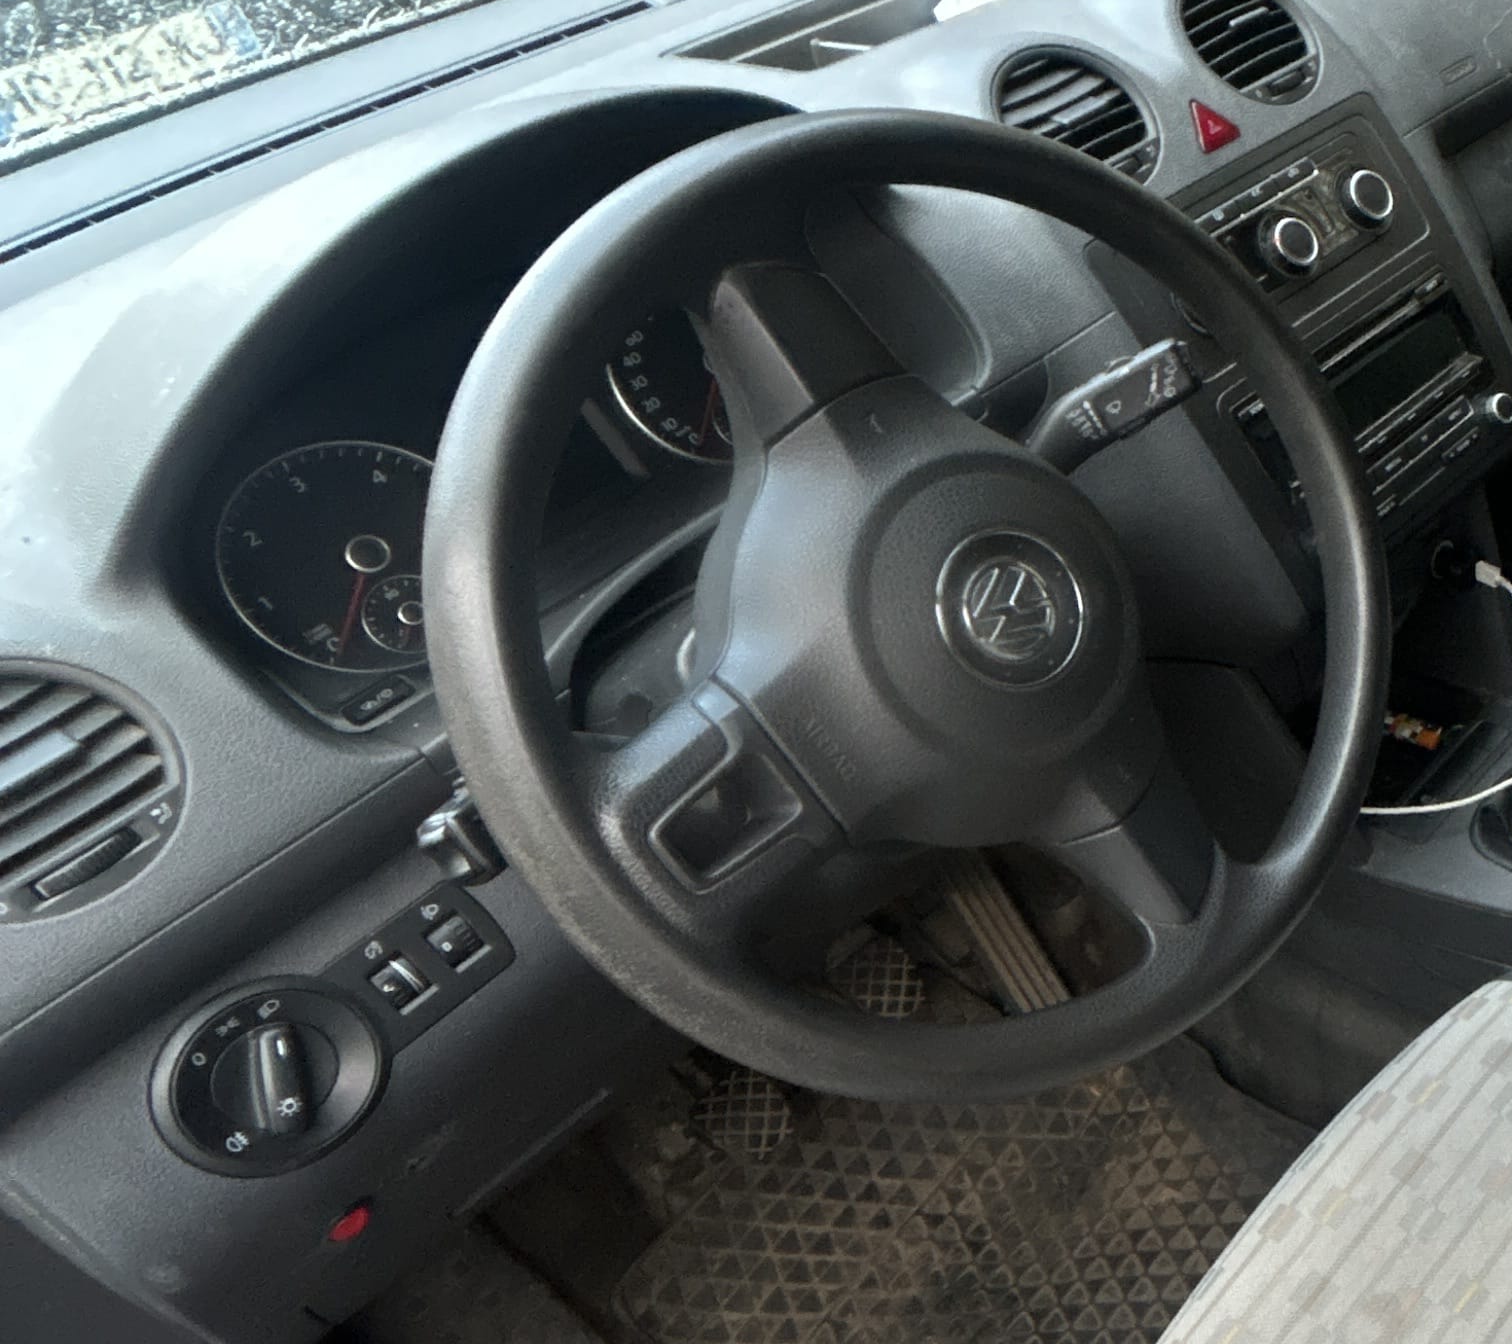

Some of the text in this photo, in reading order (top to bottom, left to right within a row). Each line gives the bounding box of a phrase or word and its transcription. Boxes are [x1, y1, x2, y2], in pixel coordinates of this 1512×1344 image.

[372, 469, 387, 484] 4
[289, 477, 306, 493] 3
[243, 531, 263, 547] 2
